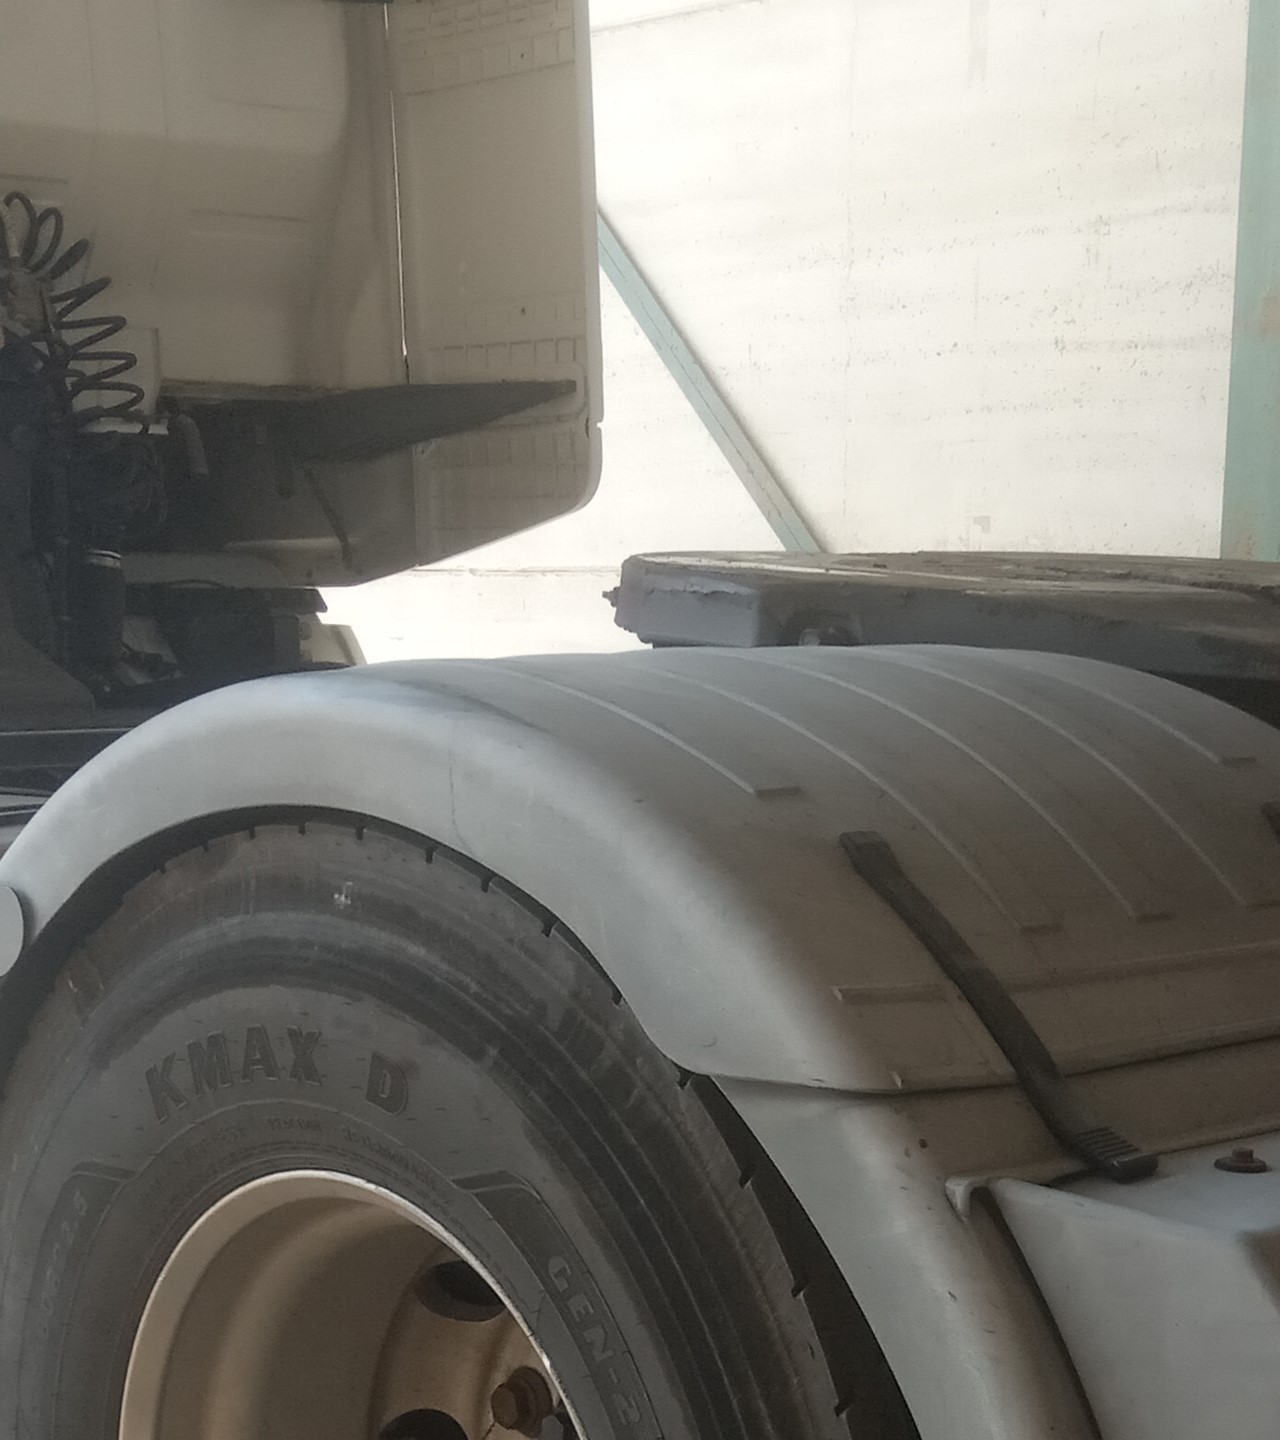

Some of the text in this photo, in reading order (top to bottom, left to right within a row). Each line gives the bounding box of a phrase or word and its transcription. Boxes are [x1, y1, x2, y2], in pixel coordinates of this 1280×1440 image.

[144, 1023, 409, 1125] KMAX D
[547, 1254, 642, 1427] GEN-2
